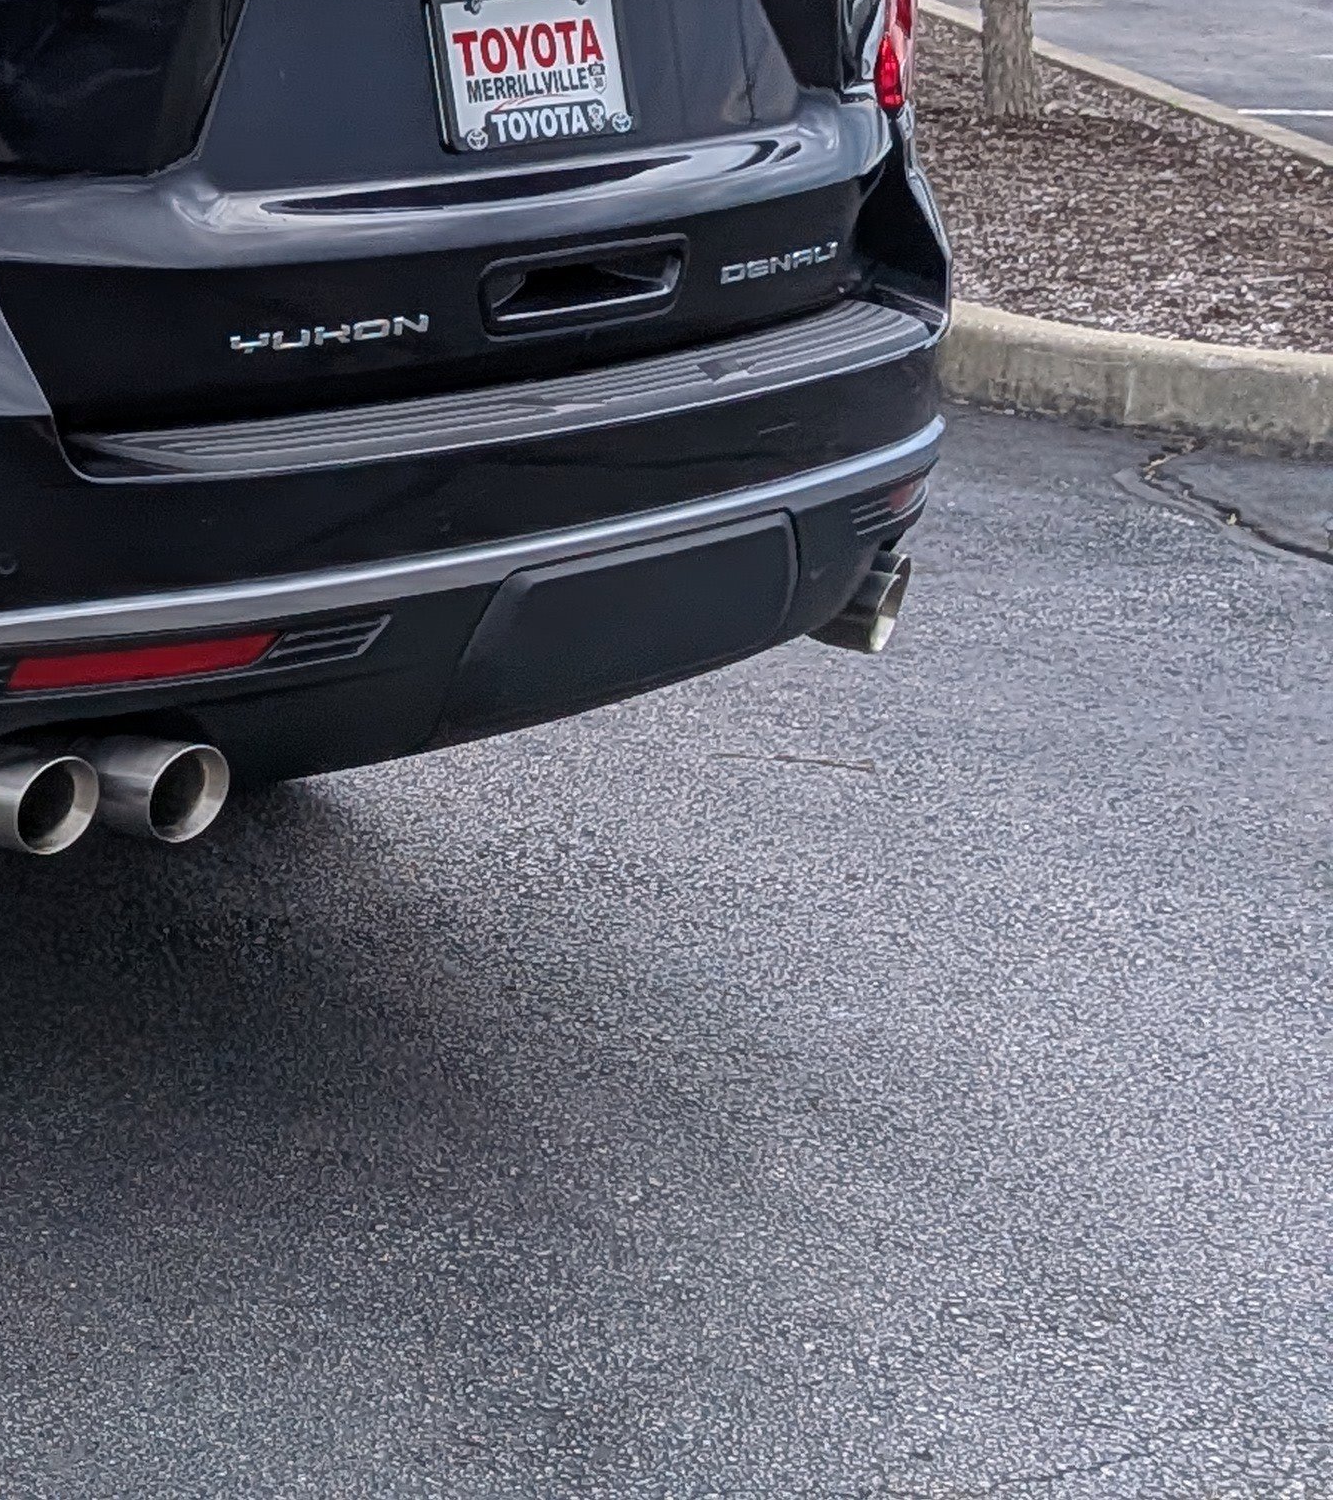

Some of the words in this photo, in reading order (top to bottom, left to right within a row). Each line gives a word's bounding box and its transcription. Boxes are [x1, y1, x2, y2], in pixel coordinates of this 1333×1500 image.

[452, 18, 604, 77] TOYOTA
[466, 67, 590, 104] MERRILLVILLE
[491, 105, 590, 143] TOYOTA
[720, 241, 838, 284] DENALI
[230, 314, 429, 354] YUKON
